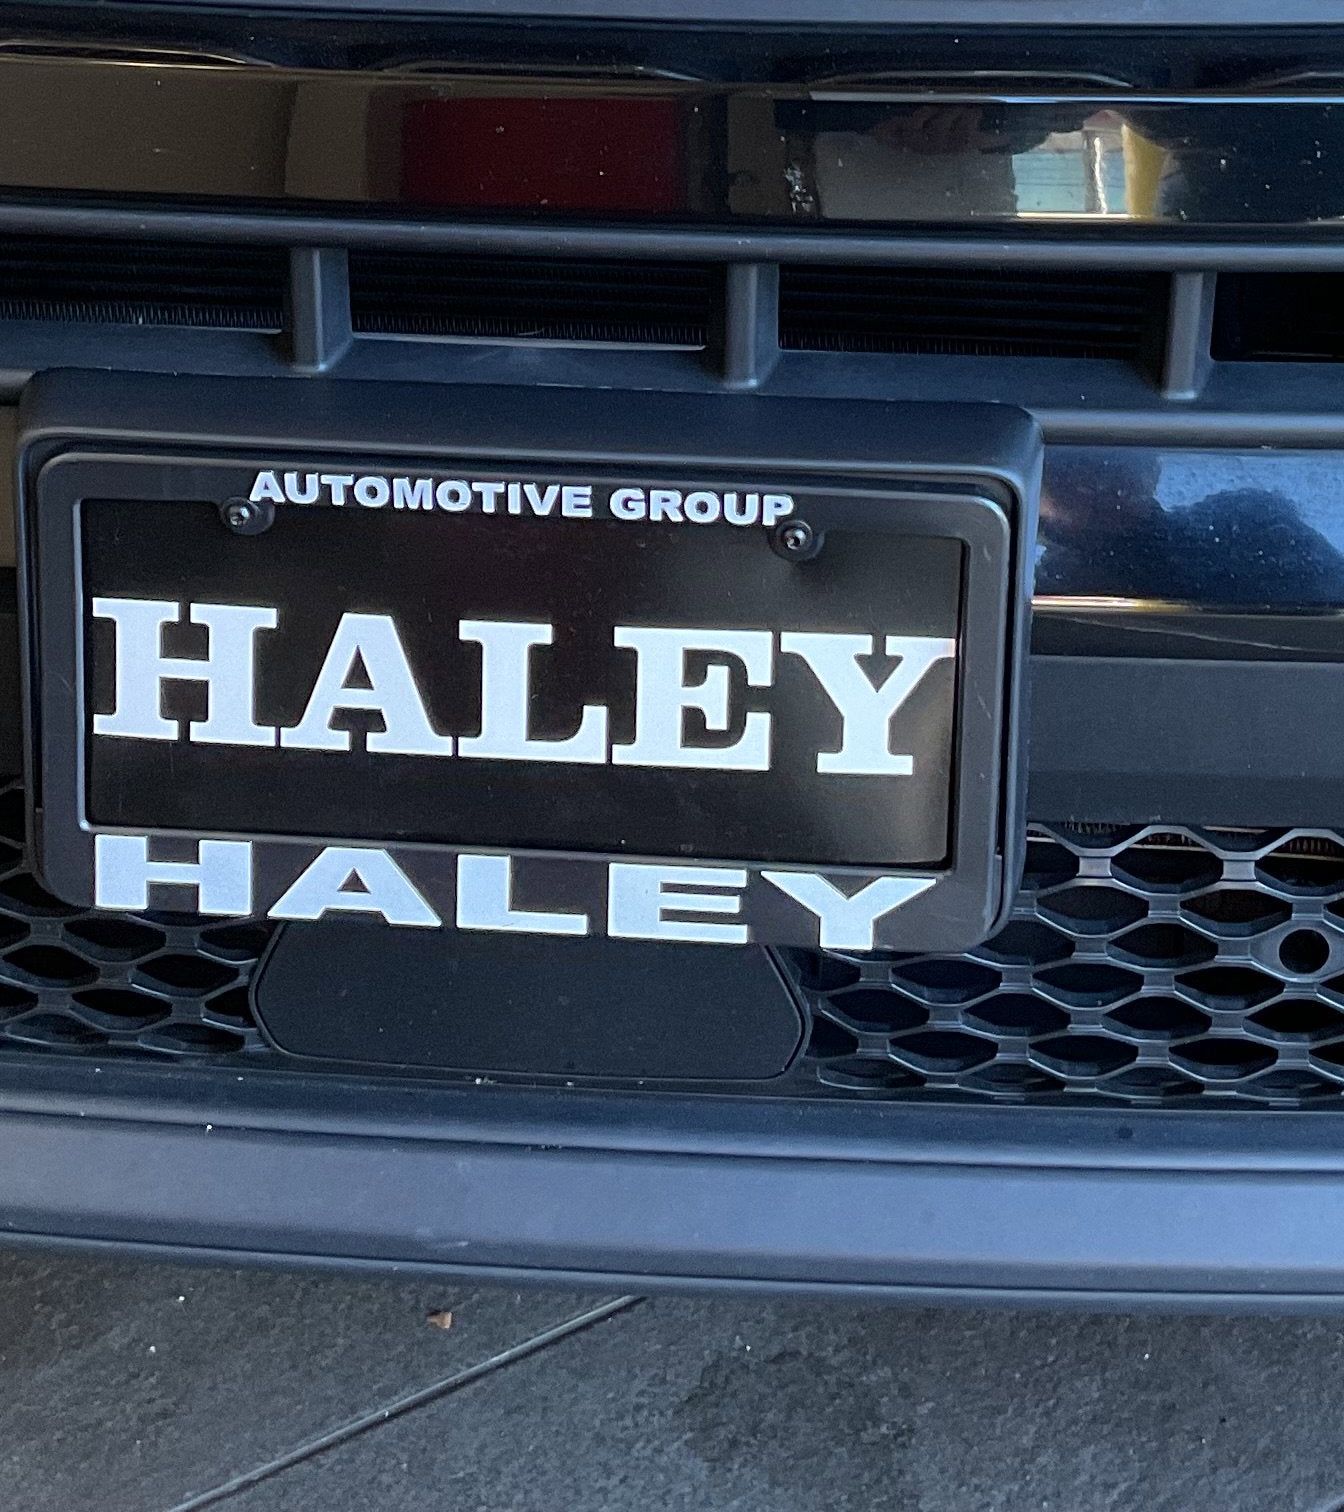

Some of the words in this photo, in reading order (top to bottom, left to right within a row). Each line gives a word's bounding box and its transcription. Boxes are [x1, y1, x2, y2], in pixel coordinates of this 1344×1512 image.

[248, 468, 593, 518] AUTOMOTIVE
[609, 487, 795, 527] GROUP
[92, 596, 956, 776] HALEY
[94, 833, 937, 951] HALEY
